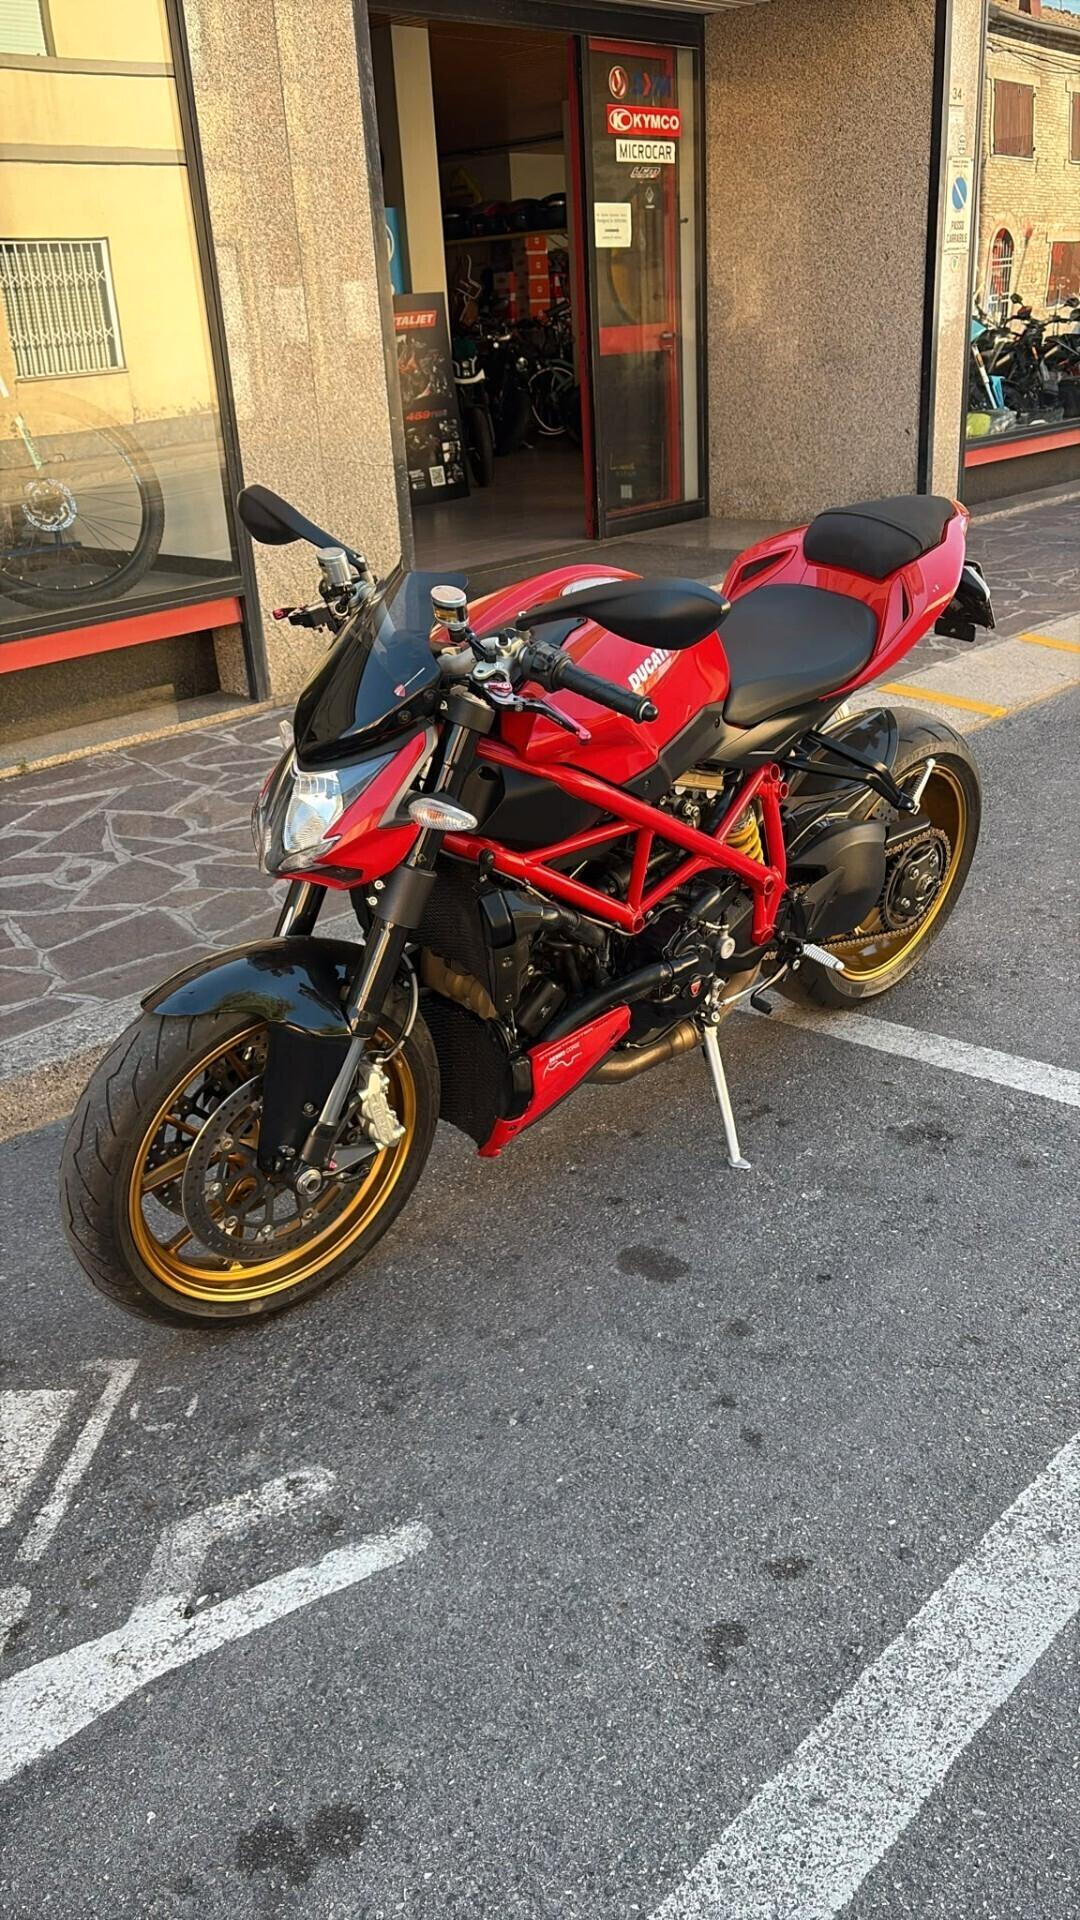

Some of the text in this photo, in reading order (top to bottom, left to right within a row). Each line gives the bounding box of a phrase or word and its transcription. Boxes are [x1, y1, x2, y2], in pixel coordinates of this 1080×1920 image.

[952, 87, 962, 100] 34
[632, 113, 680, 130] KYMCO
[619, 144, 672, 160] MICROCAR
[395, 313, 434, 327] TALJET
